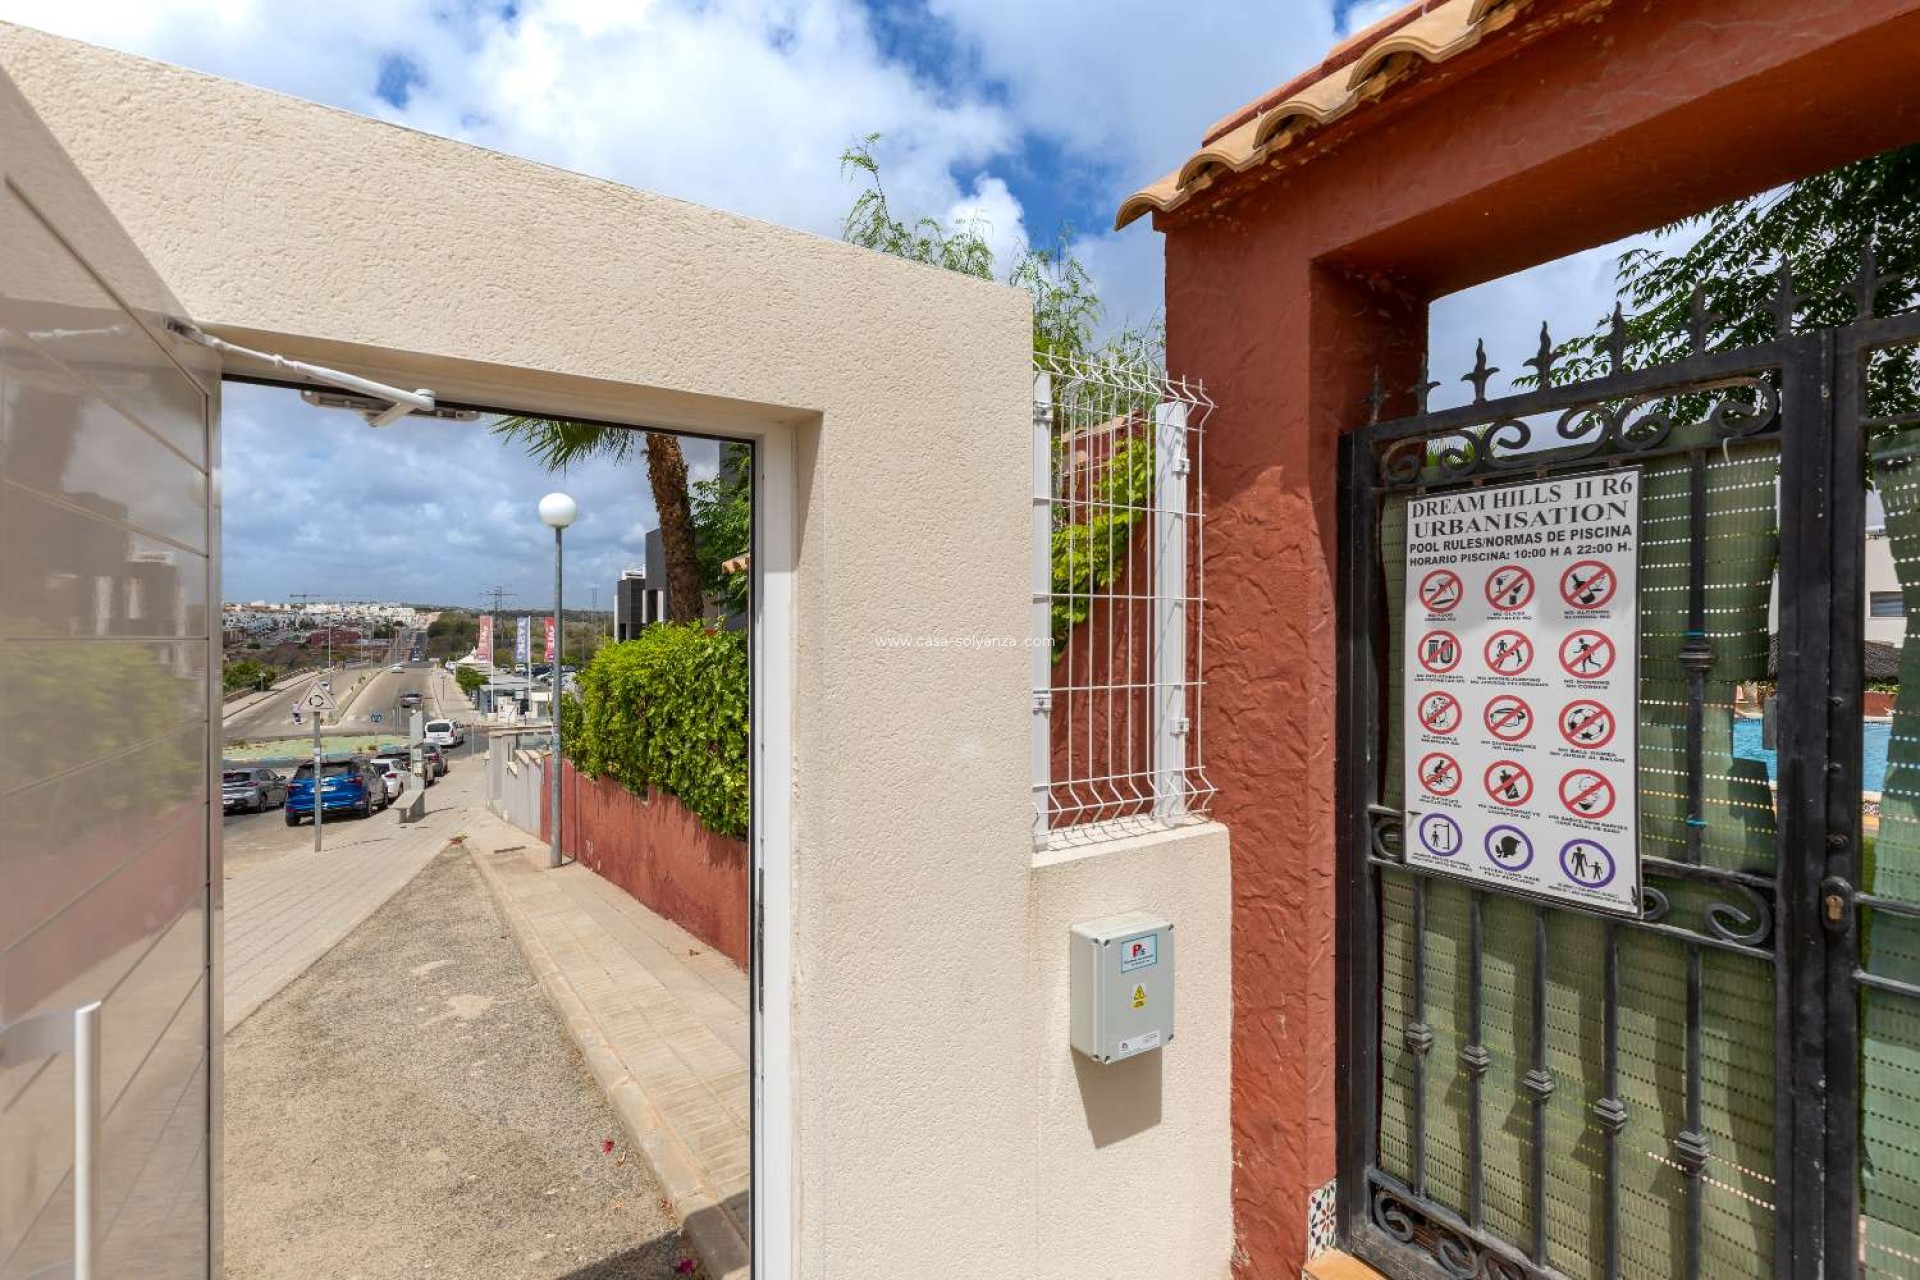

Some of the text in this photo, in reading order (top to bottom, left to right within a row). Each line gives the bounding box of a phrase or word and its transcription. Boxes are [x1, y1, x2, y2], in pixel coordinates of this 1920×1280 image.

[1412, 474, 1633, 518] DREAM HILLS II R6
[1414, 500, 1629, 538] URBANISATION
[1409, 541, 1439, 553] POOL
[1547, 530, 1565, 541] DE
[1570, 524, 1632, 541] PISCINA
[1410, 555, 1457, 567] HORARIO
[1460, 552, 1510, 563] PISCINA:
[1514, 548, 1546, 559] 10:00
[1550, 547, 1559, 556] H
[1563, 546, 1572, 556] A
[1576, 543, 1613, 555] 22:00
